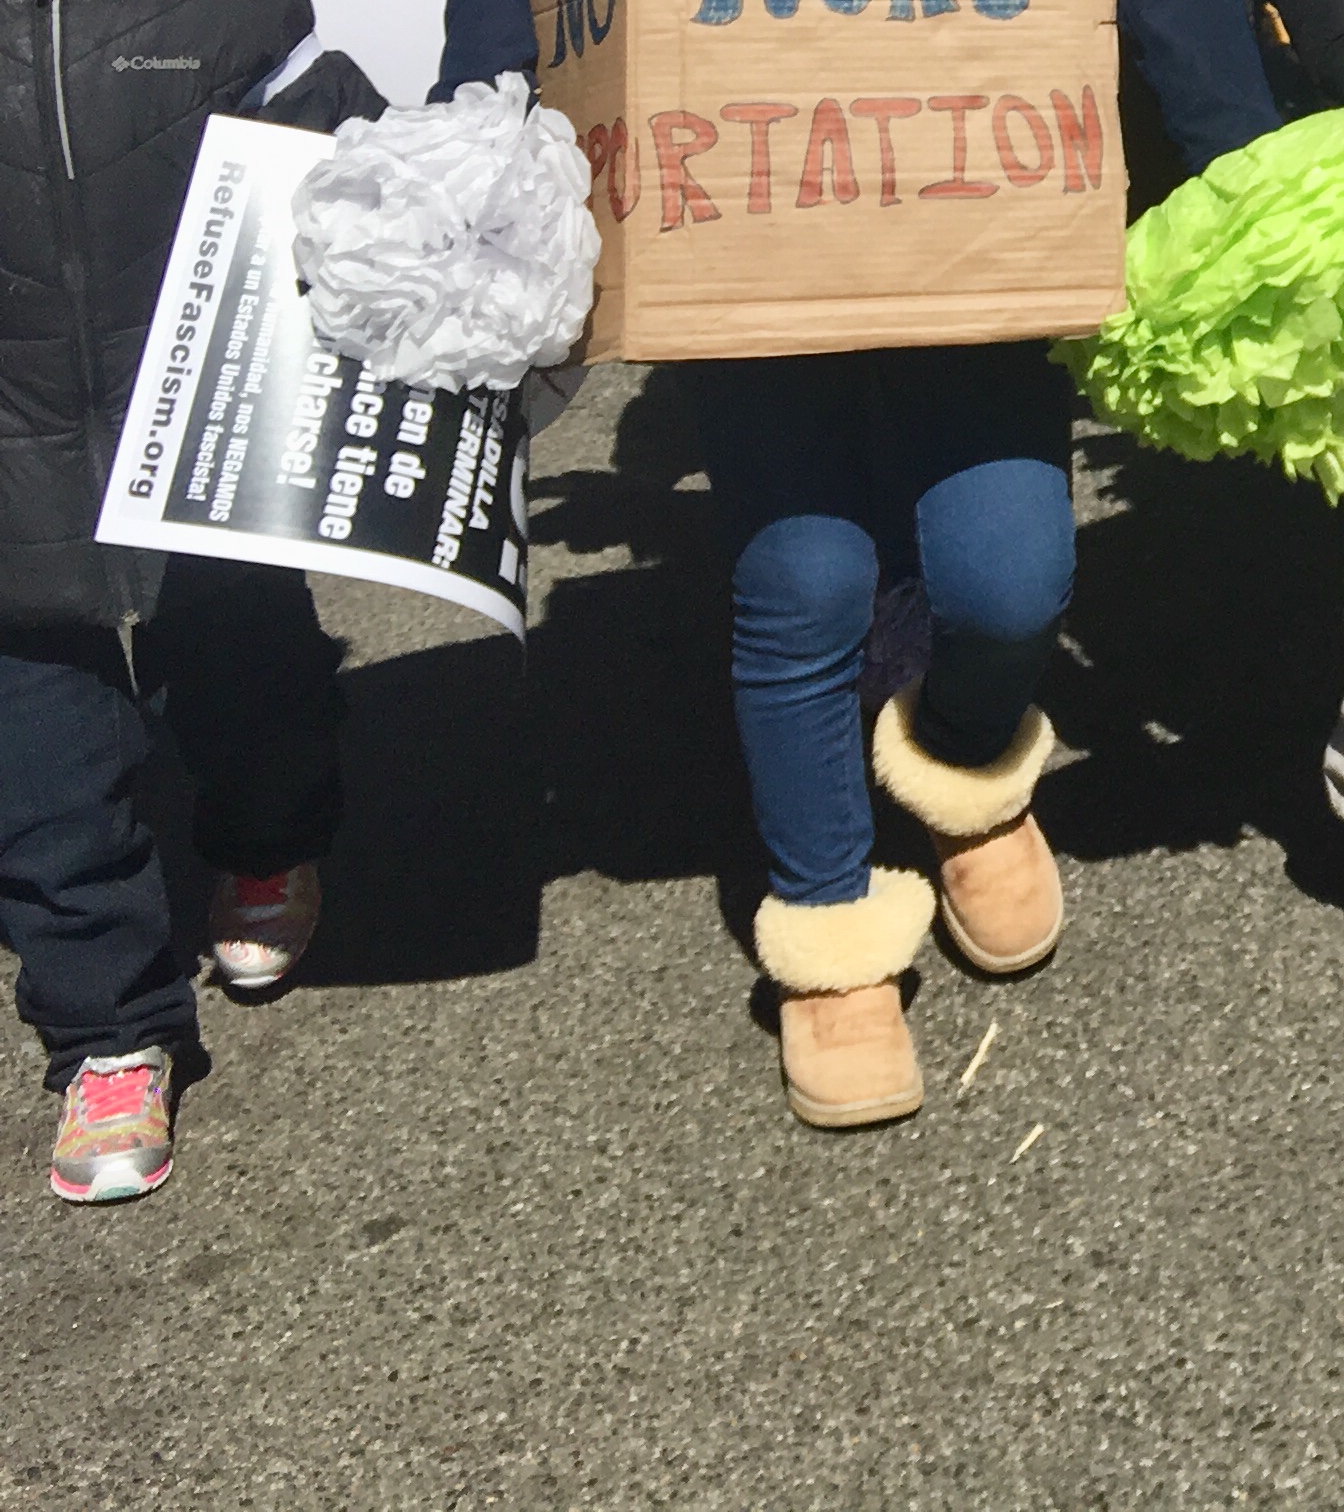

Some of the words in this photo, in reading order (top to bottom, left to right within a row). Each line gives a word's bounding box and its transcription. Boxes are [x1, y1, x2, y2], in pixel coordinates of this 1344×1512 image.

[130, 55, 201, 70] Columbia
[577, 85, 1102, 233] PORTATION
[129, 160, 247, 502] RefuseFascism.org
[225, 291, 259, 361] Estados
[208, 363, 242, 420] Unidos
[232, 403, 254, 436] nos
[276, 350, 343, 489] charse!
[186, 423, 226, 502] fascista!
[210, 437, 248, 522] NEGAMOS
[318, 445, 378, 540] tiene
[384, 451, 426, 499] de
[432, 394, 489, 569] TERMINAR:
